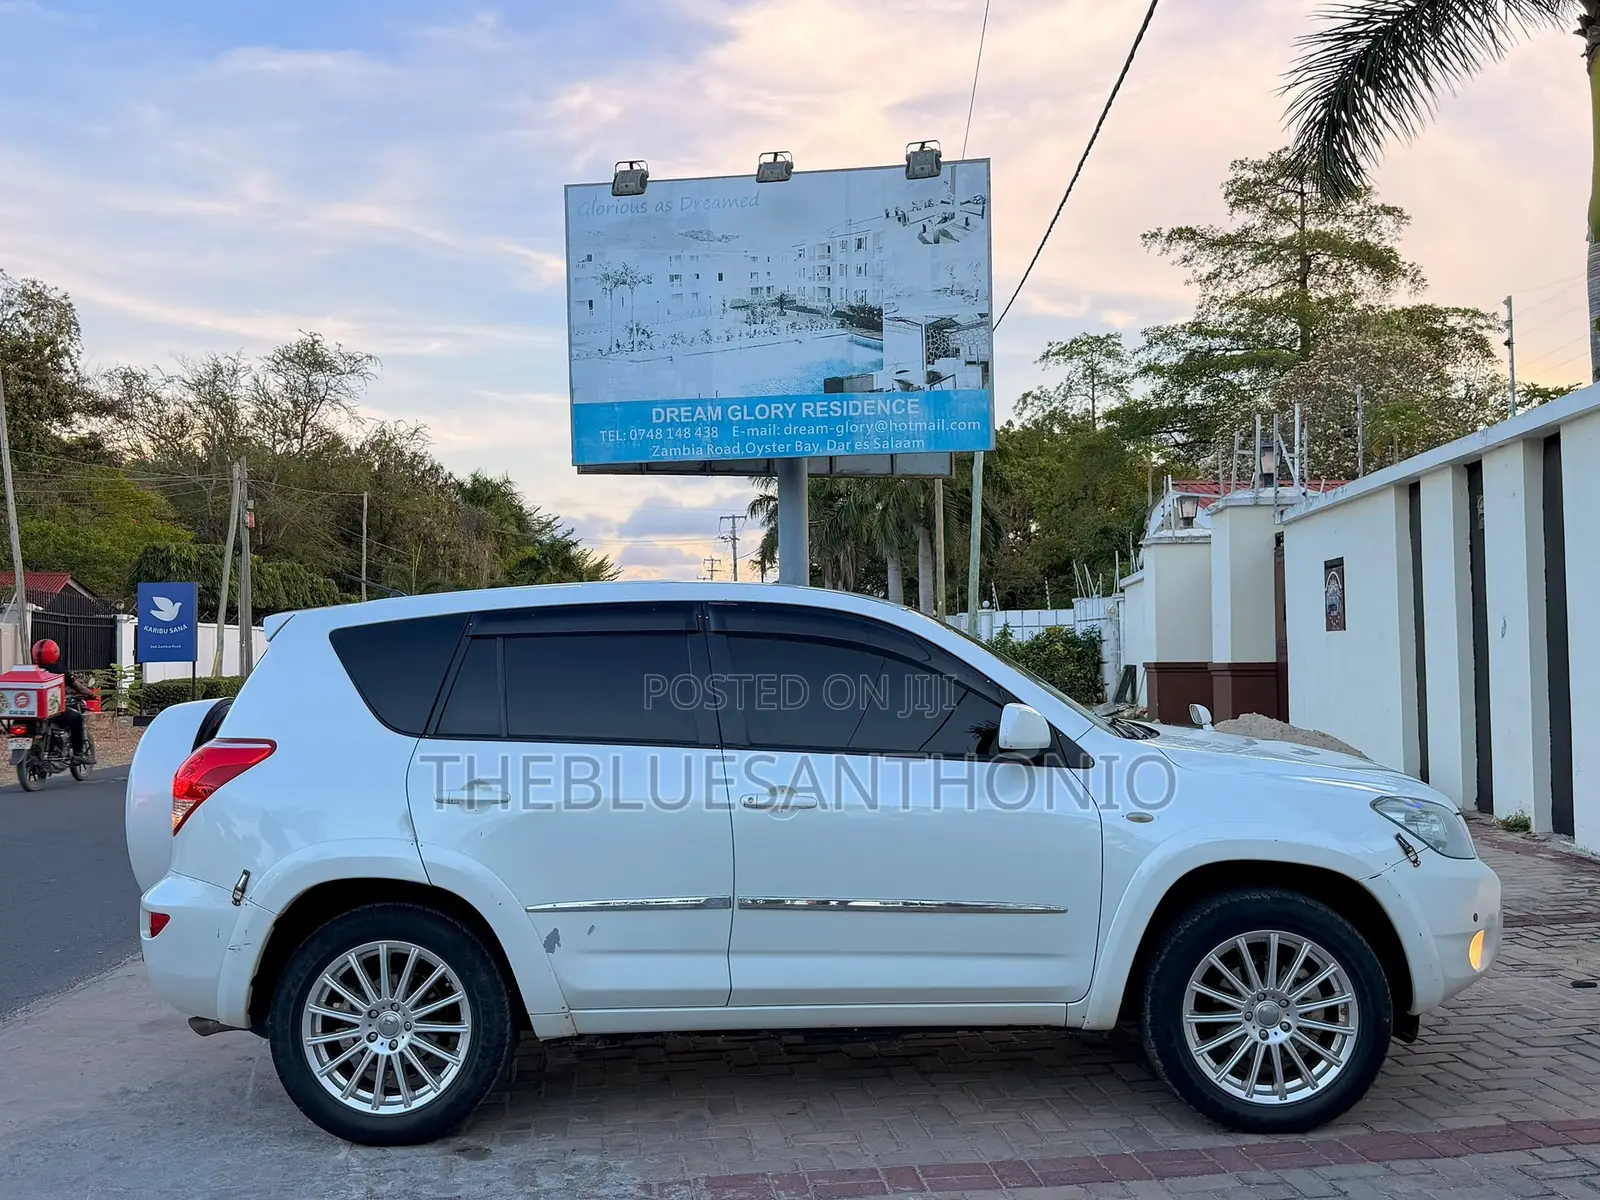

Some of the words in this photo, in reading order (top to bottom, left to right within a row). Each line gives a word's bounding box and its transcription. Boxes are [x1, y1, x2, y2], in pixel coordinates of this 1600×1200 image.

[577, 193, 647, 217] Glorious
[655, 201, 672, 213] as
[680, 190, 761, 212] Dreamed
[652, 405, 722, 423] DREAM
[727, 402, 797, 421] GLORY
[802, 398, 920, 418] RESIDENCE
[600, 430, 626, 442] TEL:
[629, 428, 663, 441] 0748
[666, 427, 691, 439] 148
[695, 426, 719, 438] 438
[732, 424, 780, 437] E-mail:
[784, 418, 980, 436] dream-glory@hotmail.com
[652, 444, 703, 457] Zambia
[795, 440, 823, 454] Bay,
[826, 439, 851, 451] Dar
[855, 439, 870, 450] es
[873, 436, 925, 449] Salaam
[143, 624, 168, 635] KARIBU
[169, 623, 188, 634] SANA
